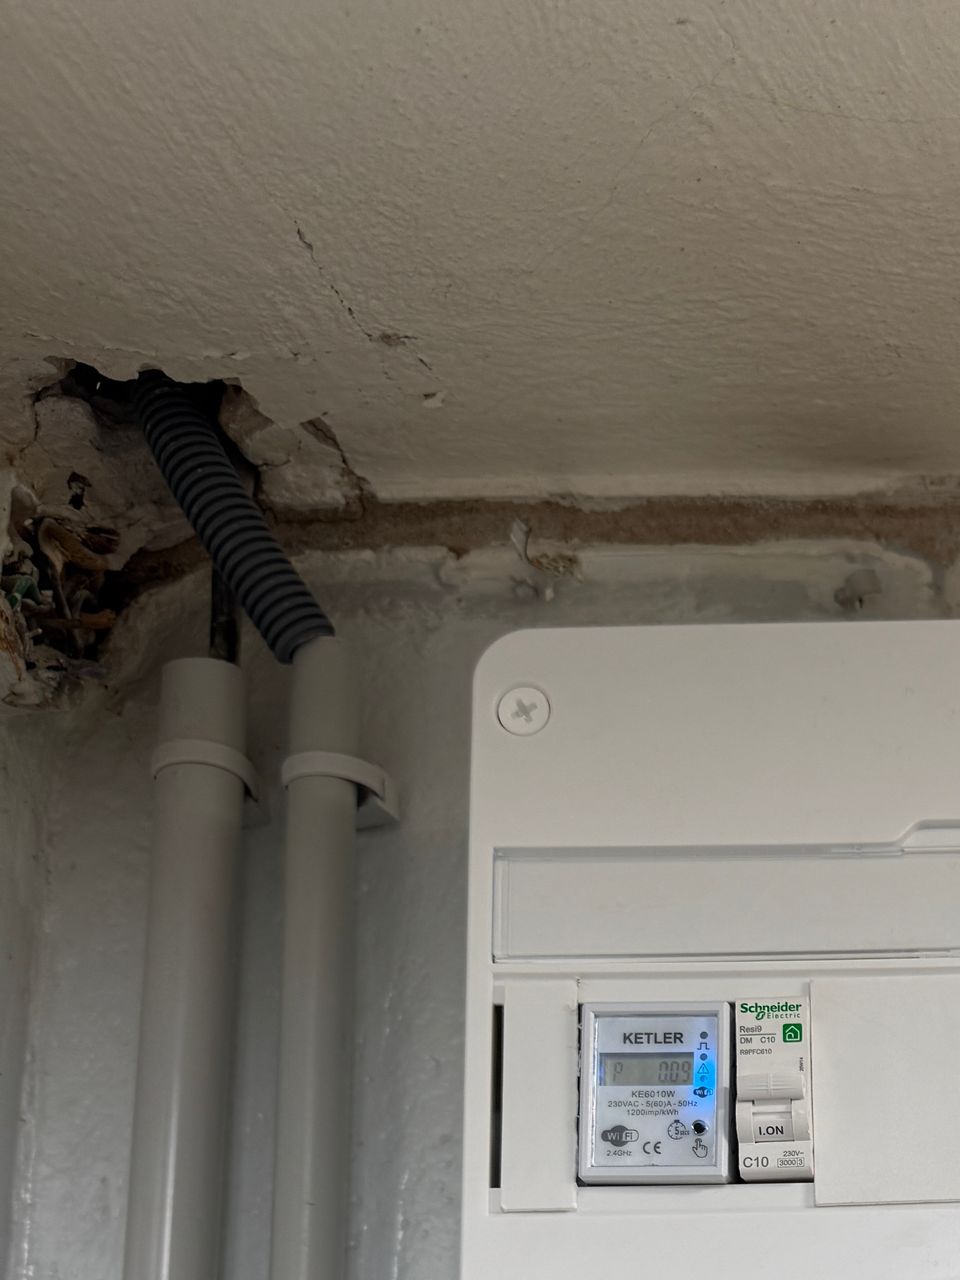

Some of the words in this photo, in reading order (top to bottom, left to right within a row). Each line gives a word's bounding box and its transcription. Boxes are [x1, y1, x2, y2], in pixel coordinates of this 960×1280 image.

[740, 1001, 802, 1013] Schneider
[740, 1025, 763, 1033] Resi9
[622, 1032, 684, 1044] KETLER
[760, 1036, 776, 1044] C10
[631, 1090, 676, 1098] KE6010W
[742, 1156, 769, 1168] C10
